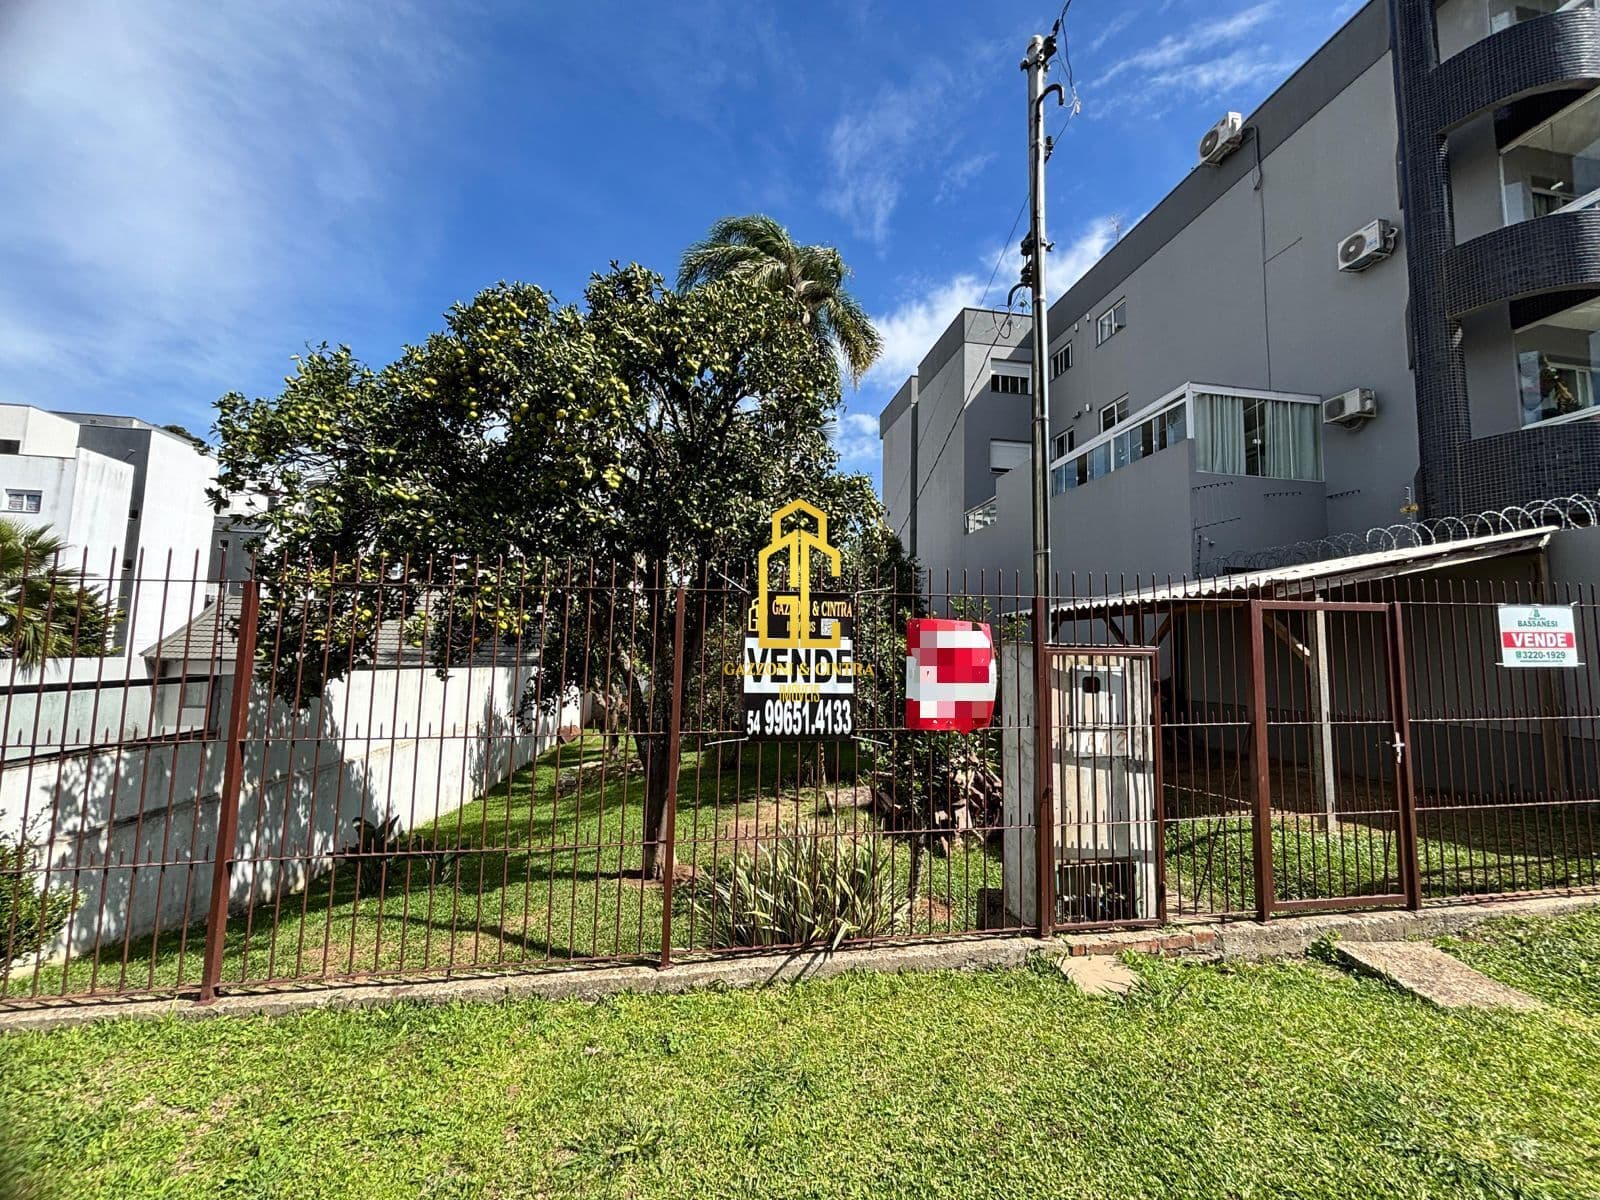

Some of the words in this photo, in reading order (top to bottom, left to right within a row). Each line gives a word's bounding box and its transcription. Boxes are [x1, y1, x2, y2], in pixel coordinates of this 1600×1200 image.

[812, 601, 820, 616] &
[821, 601, 853, 618] CINTRA
[1512, 633, 1567, 647] VENDE
[1523, 651, 1566, 659] 3220-1929
[747, 648, 854, 683] VENDE
[747, 710, 760, 735] 54
[764, 699, 852, 736] 99651.4133
